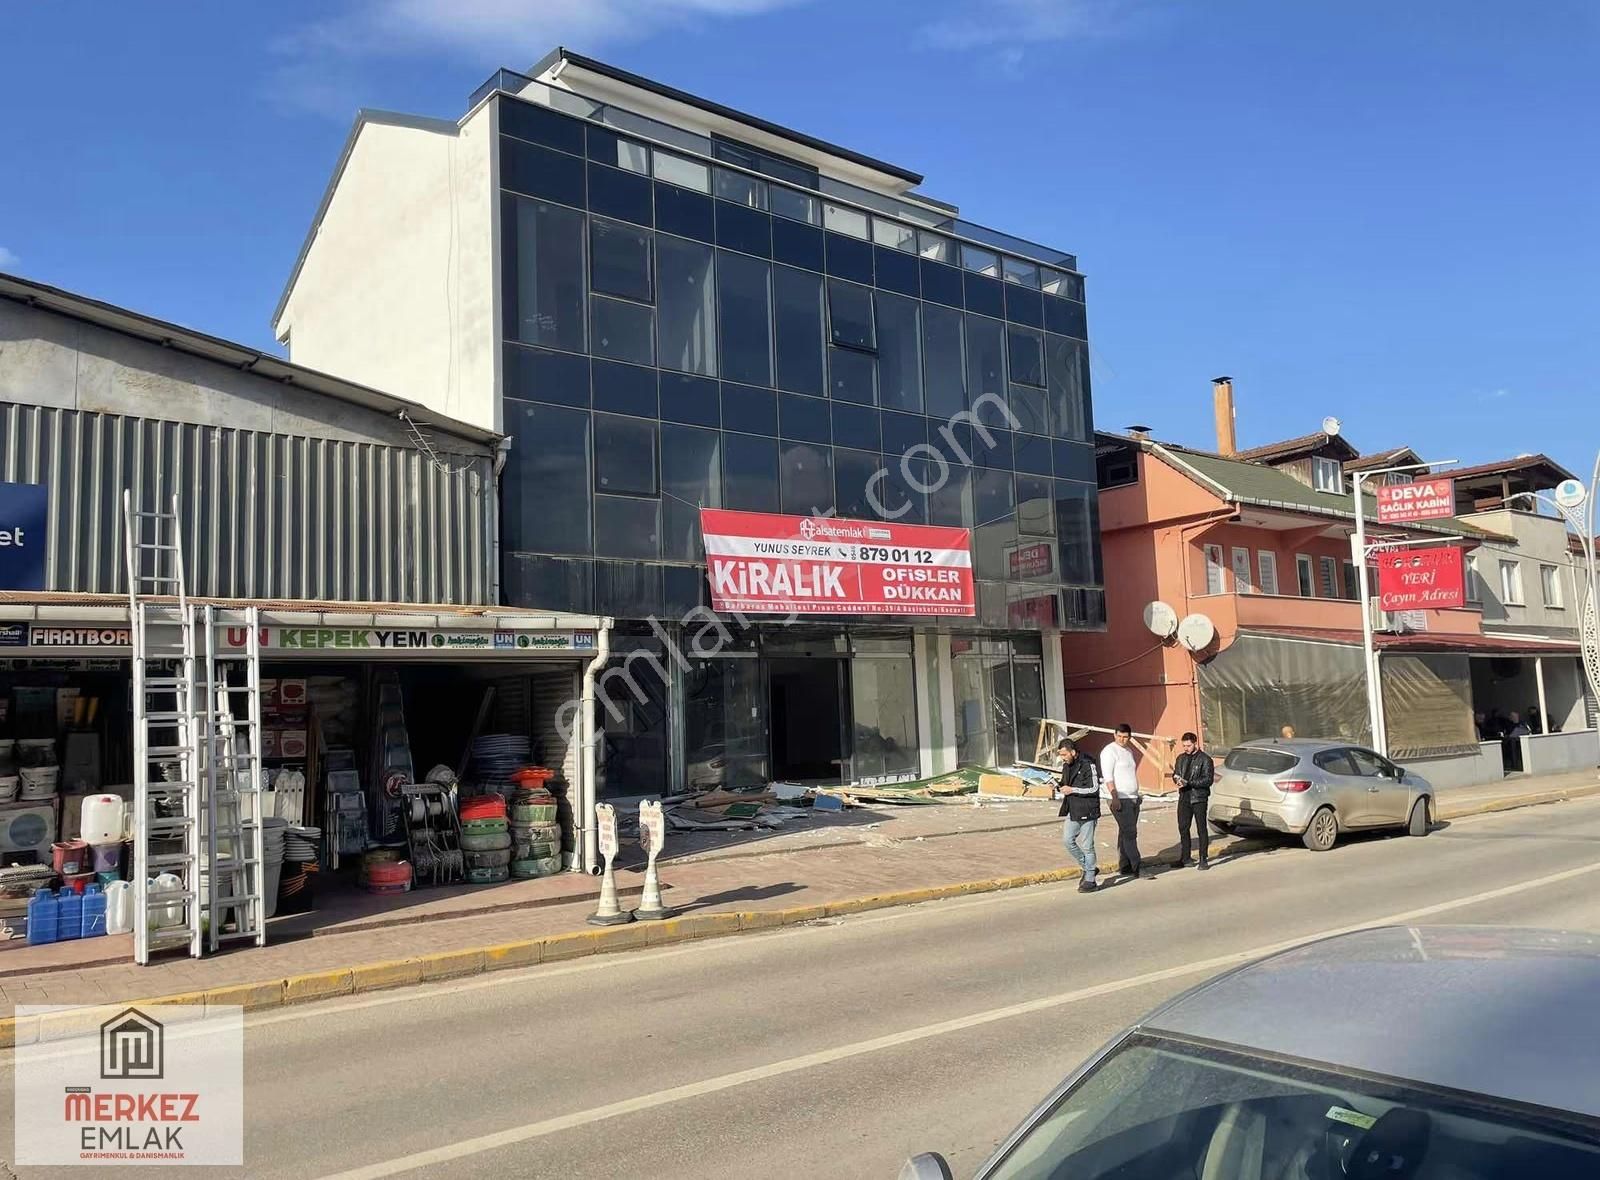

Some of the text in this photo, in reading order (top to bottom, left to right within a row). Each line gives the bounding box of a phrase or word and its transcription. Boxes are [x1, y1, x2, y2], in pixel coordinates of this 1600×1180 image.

[1391, 485, 1435, 500] DEVA
[1380, 501, 1415, 513] SAĞLIK
[1416, 495, 1450, 509] KABİNİ
[0, 527, 24, 547] et
[815, 526, 865, 538] alsatemlak
[754, 543, 831, 557] YUNUS SEYREK
[860, 547, 933, 564] 879 01 12
[1402, 569, 1436, 585] YERİ
[883, 583, 962, 601] DÜKKAN
[1383, 588, 1459, 607] Çayın Adresi
[32, 629, 133, 645] FIRATBOR
[279, 629, 371, 648] KEPEK
[375, 631, 427, 648] YEM
[496, 635, 513, 643] UN
[575, 635, 592, 644] UN
